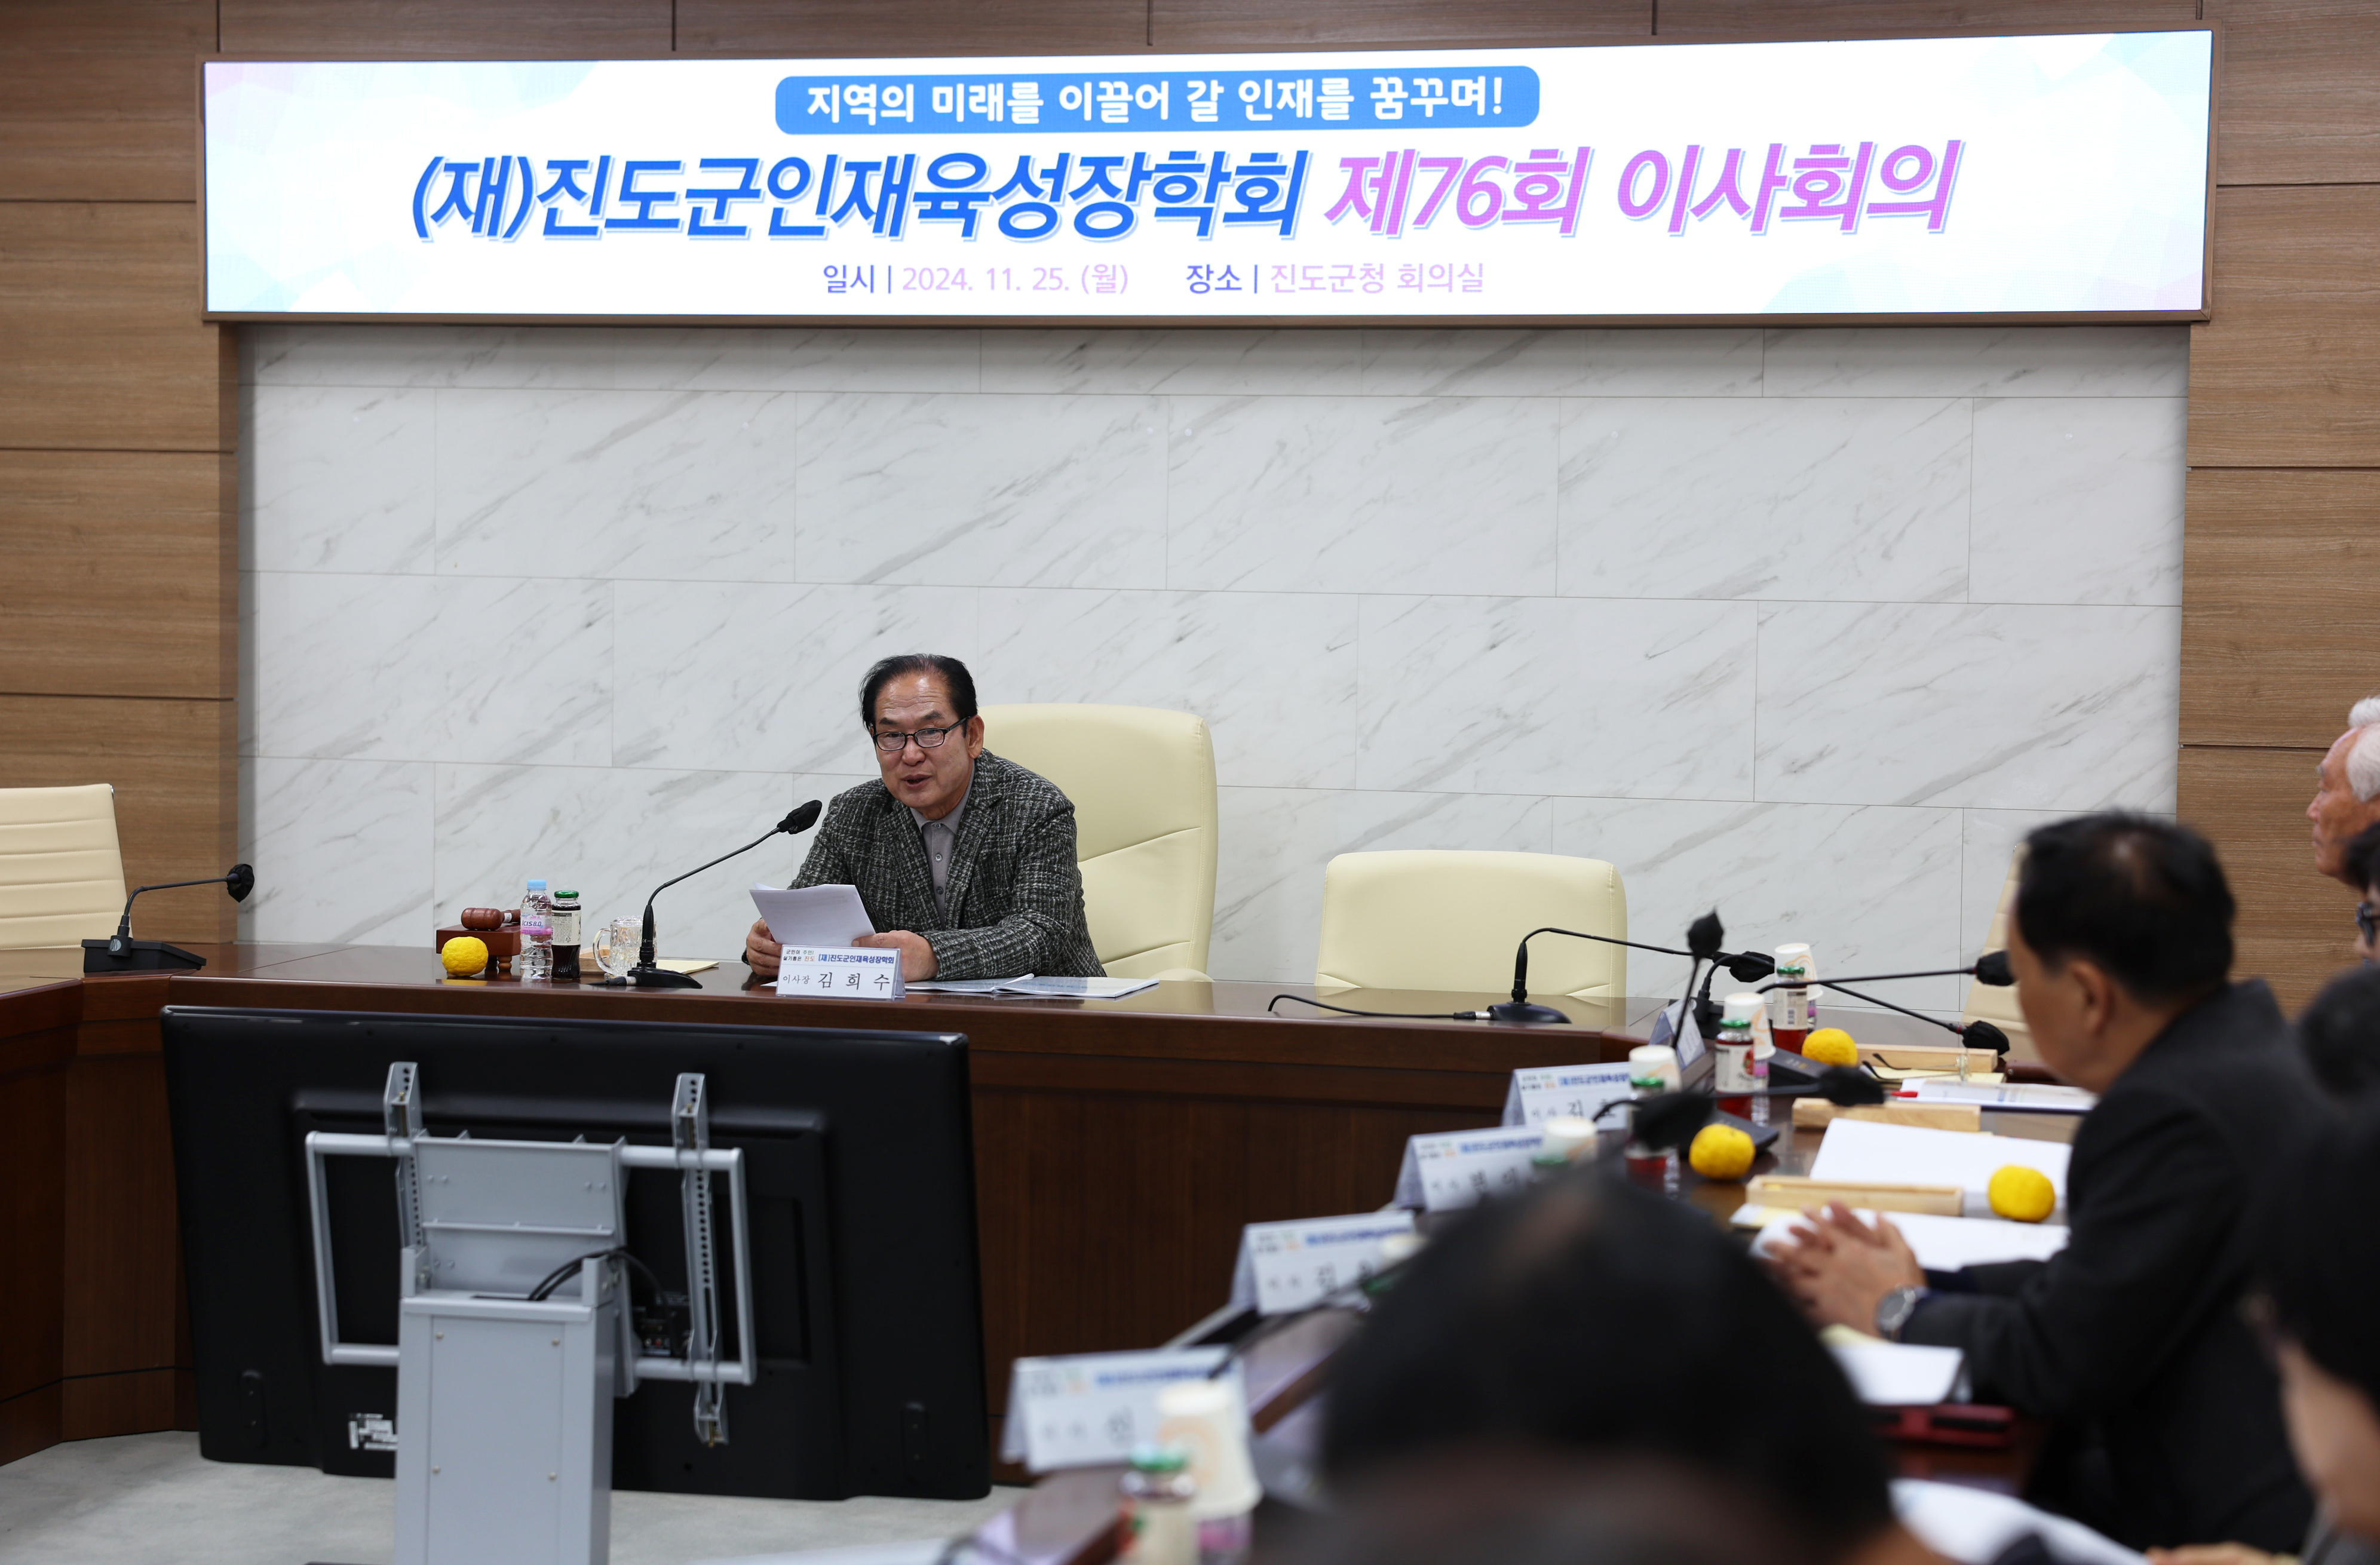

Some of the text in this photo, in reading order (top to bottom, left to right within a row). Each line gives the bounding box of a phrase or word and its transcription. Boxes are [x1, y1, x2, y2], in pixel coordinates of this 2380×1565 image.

[806, 76, 1504, 125] 지역의 미래를 이끌어 갈 인재를 꿈꾸며!
[411, 139, 1964, 240] (재)진도군인재육성장학회 제76회 이사회의
[823, 264, 876, 294] 일시
[902, 268, 974, 291] 2024.
[986, 268, 1022, 291] 11.
[1032, 267, 1070, 291] 25.
[1080, 263, 1129, 295] (월)
[1185, 263, 1244, 294] 장소
[1270, 263, 1385, 294] 진도군청
[1397, 262, 1484, 293] 회의실
[818, 953, 894, 964] (재)진도군인재육성장학회
[783, 974, 811, 984] 이사장
